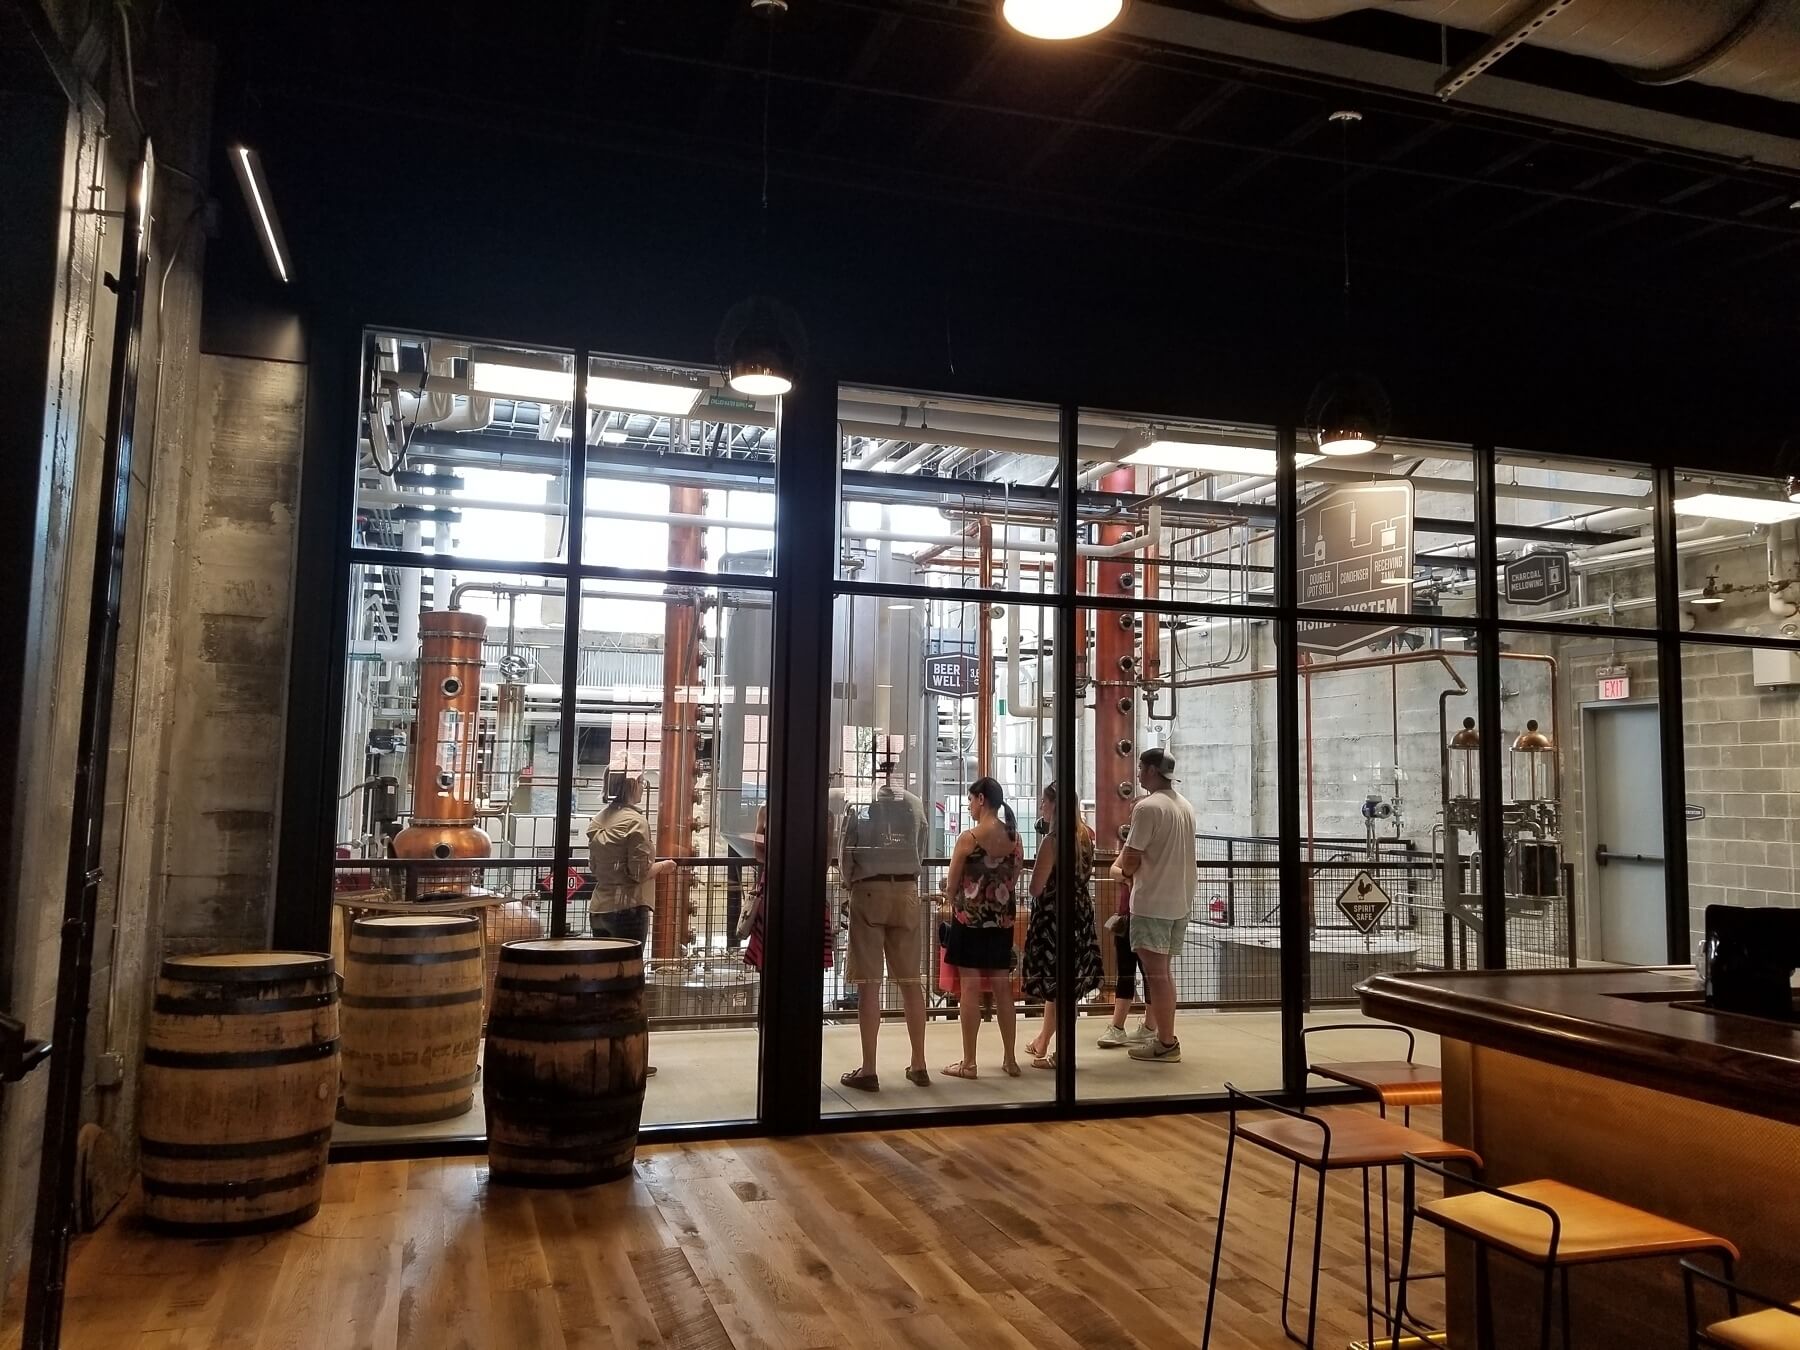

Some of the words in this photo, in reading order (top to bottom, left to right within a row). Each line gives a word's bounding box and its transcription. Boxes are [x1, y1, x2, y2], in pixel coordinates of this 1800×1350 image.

[1374, 556, 1403, 572] RECEIVING
[1309, 571, 1331, 585] DOUBLER
[1340, 568, 1369, 584] CONDENSER
[1511, 570, 1541, 581] CHARCOAL
[1307, 585, 1318, 597] (POT
[1319, 583, 1334, 597] STILL)
[1511, 579, 1544, 592] MELLOWING
[934, 663, 960, 675] BEER
[933, 675, 962, 686] WELL
[1604, 680, 1624, 697] EXIT
